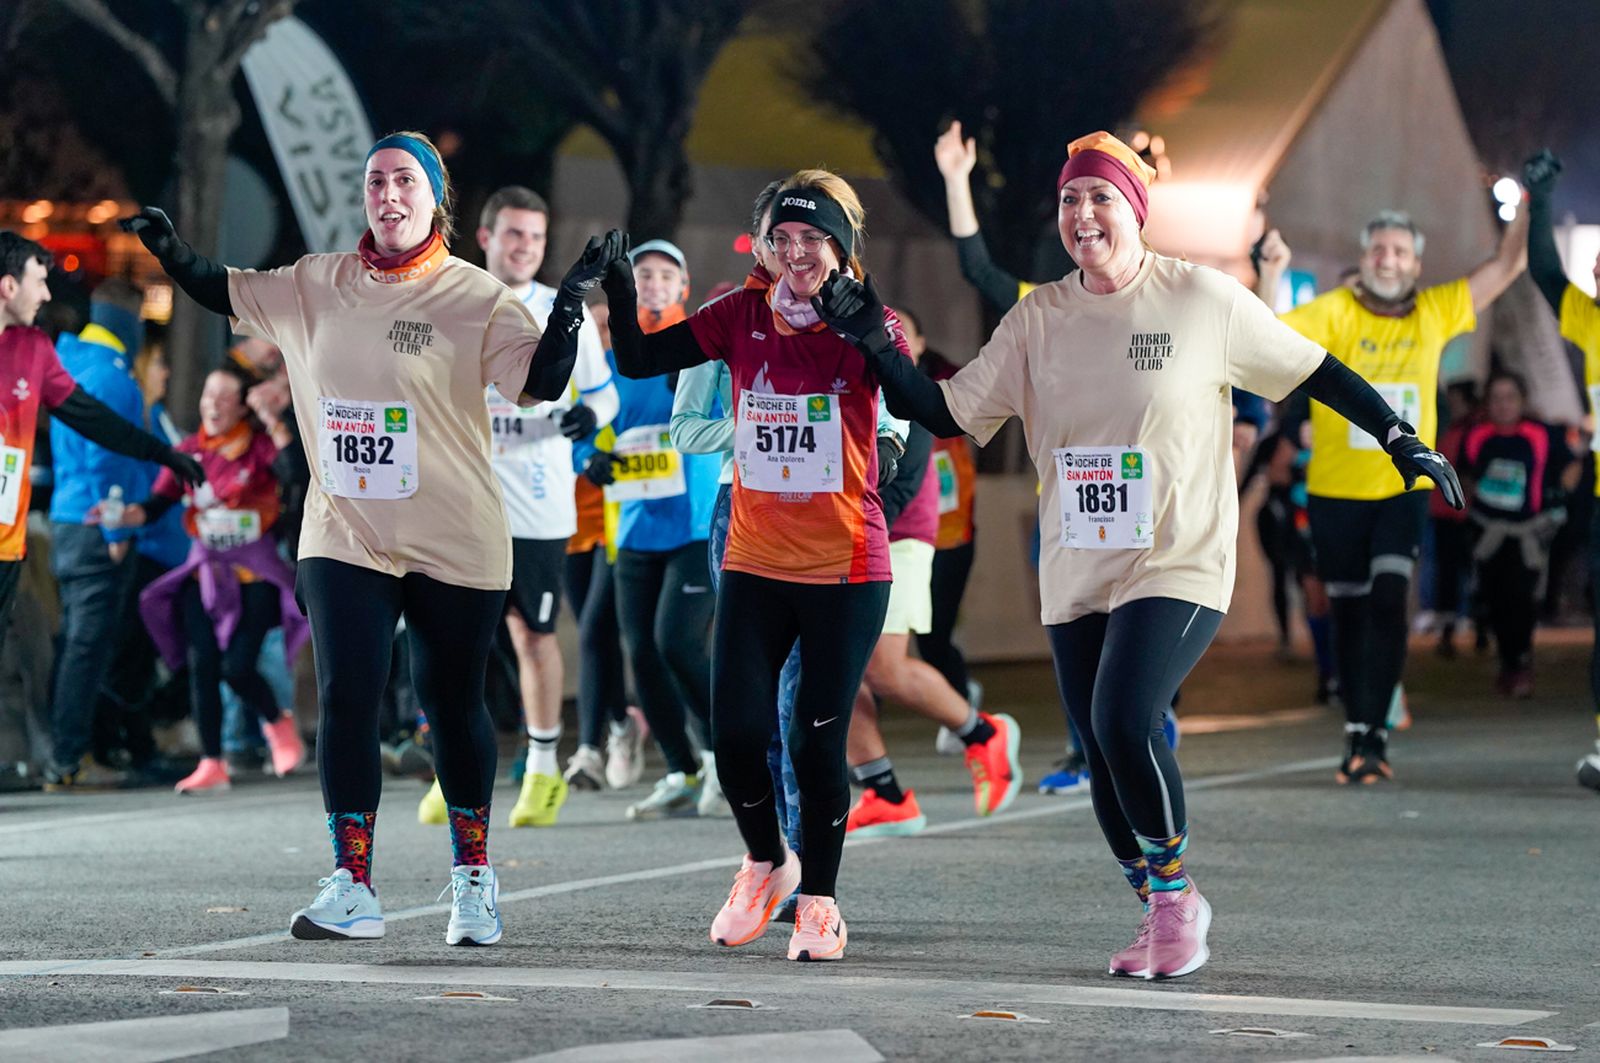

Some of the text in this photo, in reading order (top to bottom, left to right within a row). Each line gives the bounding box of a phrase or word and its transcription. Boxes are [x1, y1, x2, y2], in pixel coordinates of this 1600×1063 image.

[393, 320, 432, 334] HYBRID
[387, 330, 434, 347] ATHLETE
[1131, 333, 1171, 346] HYBRID
[393, 341, 422, 356] CLUB
[1127, 345, 1174, 359] ATHLETE
[1134, 358, 1163, 371] CLUB
[756, 401, 797, 411] NOCHE DE
[335, 409, 375, 421] NOCHE DE
[747, 411, 762, 422] SAN
[327, 419, 342, 431] SAN
[756, 425, 817, 453] 5174
[333, 434, 394, 465] 1832
[1101, 458, 1113, 467] DE
[1067, 470, 1080, 481] SAN
[1076, 483, 1128, 513] 1831
